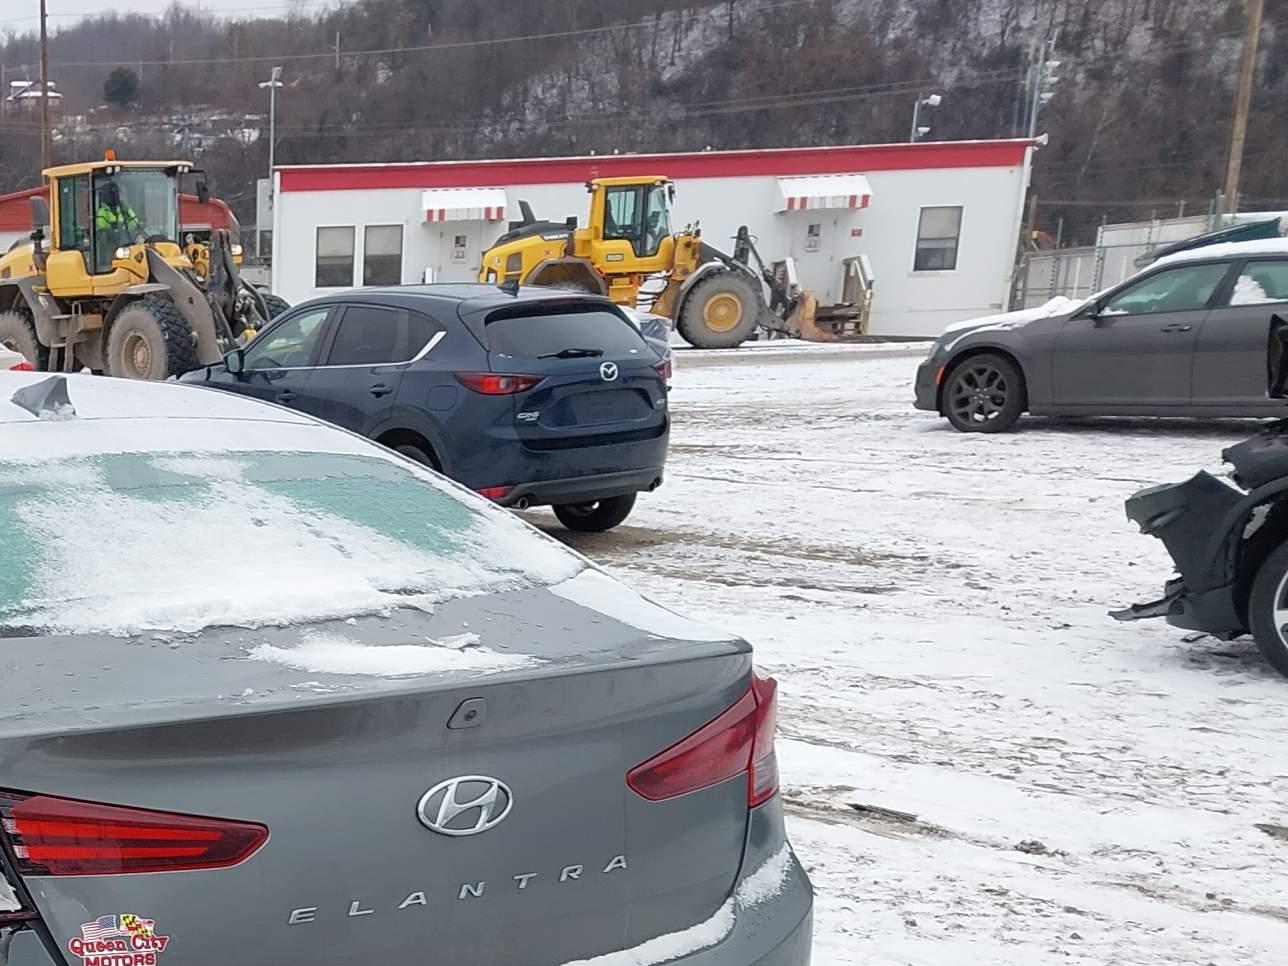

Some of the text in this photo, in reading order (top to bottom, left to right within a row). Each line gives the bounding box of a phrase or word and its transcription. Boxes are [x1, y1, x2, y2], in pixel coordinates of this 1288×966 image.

[288, 855, 628, 925] ELANTRA
[70, 934, 168, 956] Queen City
